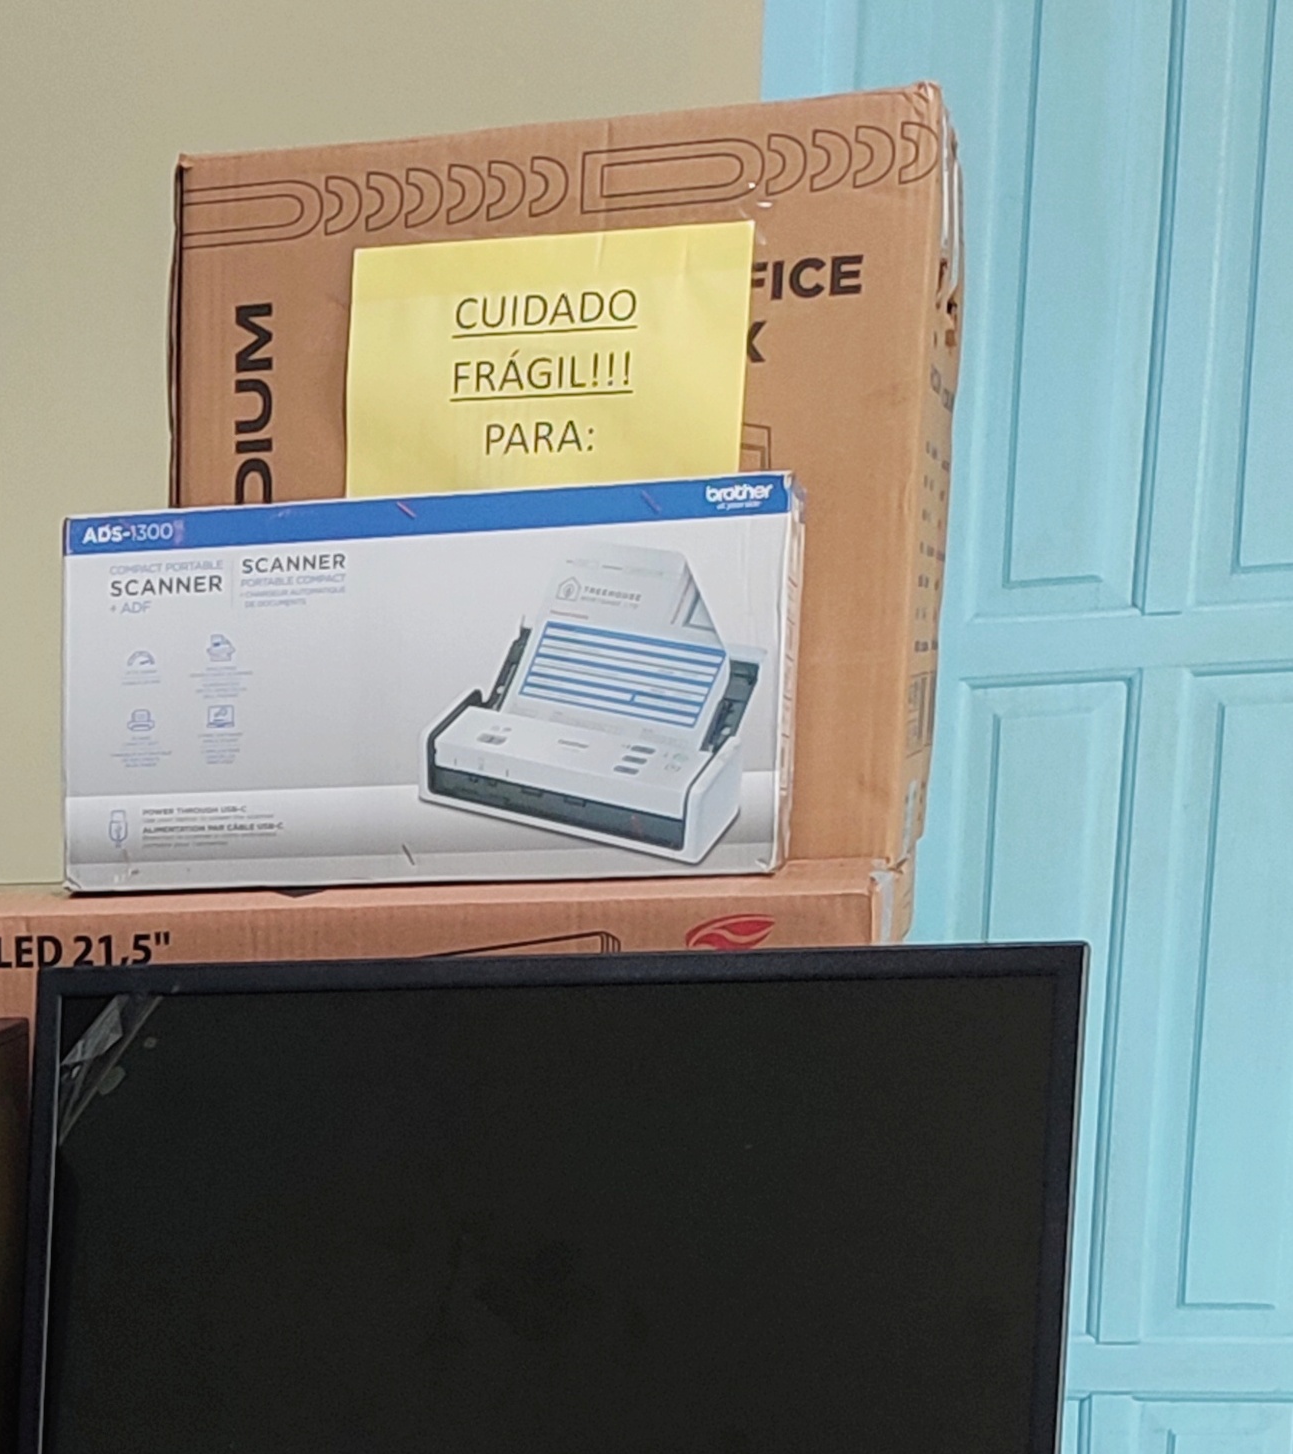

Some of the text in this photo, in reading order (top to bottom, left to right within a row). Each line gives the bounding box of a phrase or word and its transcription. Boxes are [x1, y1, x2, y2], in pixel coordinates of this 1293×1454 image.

[454, 288, 637, 330] CUIDADO
[452, 348, 631, 394] FRÁGIL!!!
[484, 419, 595, 456] PARA:
[705, 483, 774, 503] brother
[81, 521, 174, 545] ADS-1300
[109, 559, 224, 576] COMPACT PORTABLE
[241, 553, 347, 574] SCANNER
[110, 574, 223, 598] SCANNER
[240, 575, 295, 587] PORTABLE
[119, 601, 153, 615] ADF
[72, 931, 171, 968] 21,5"
